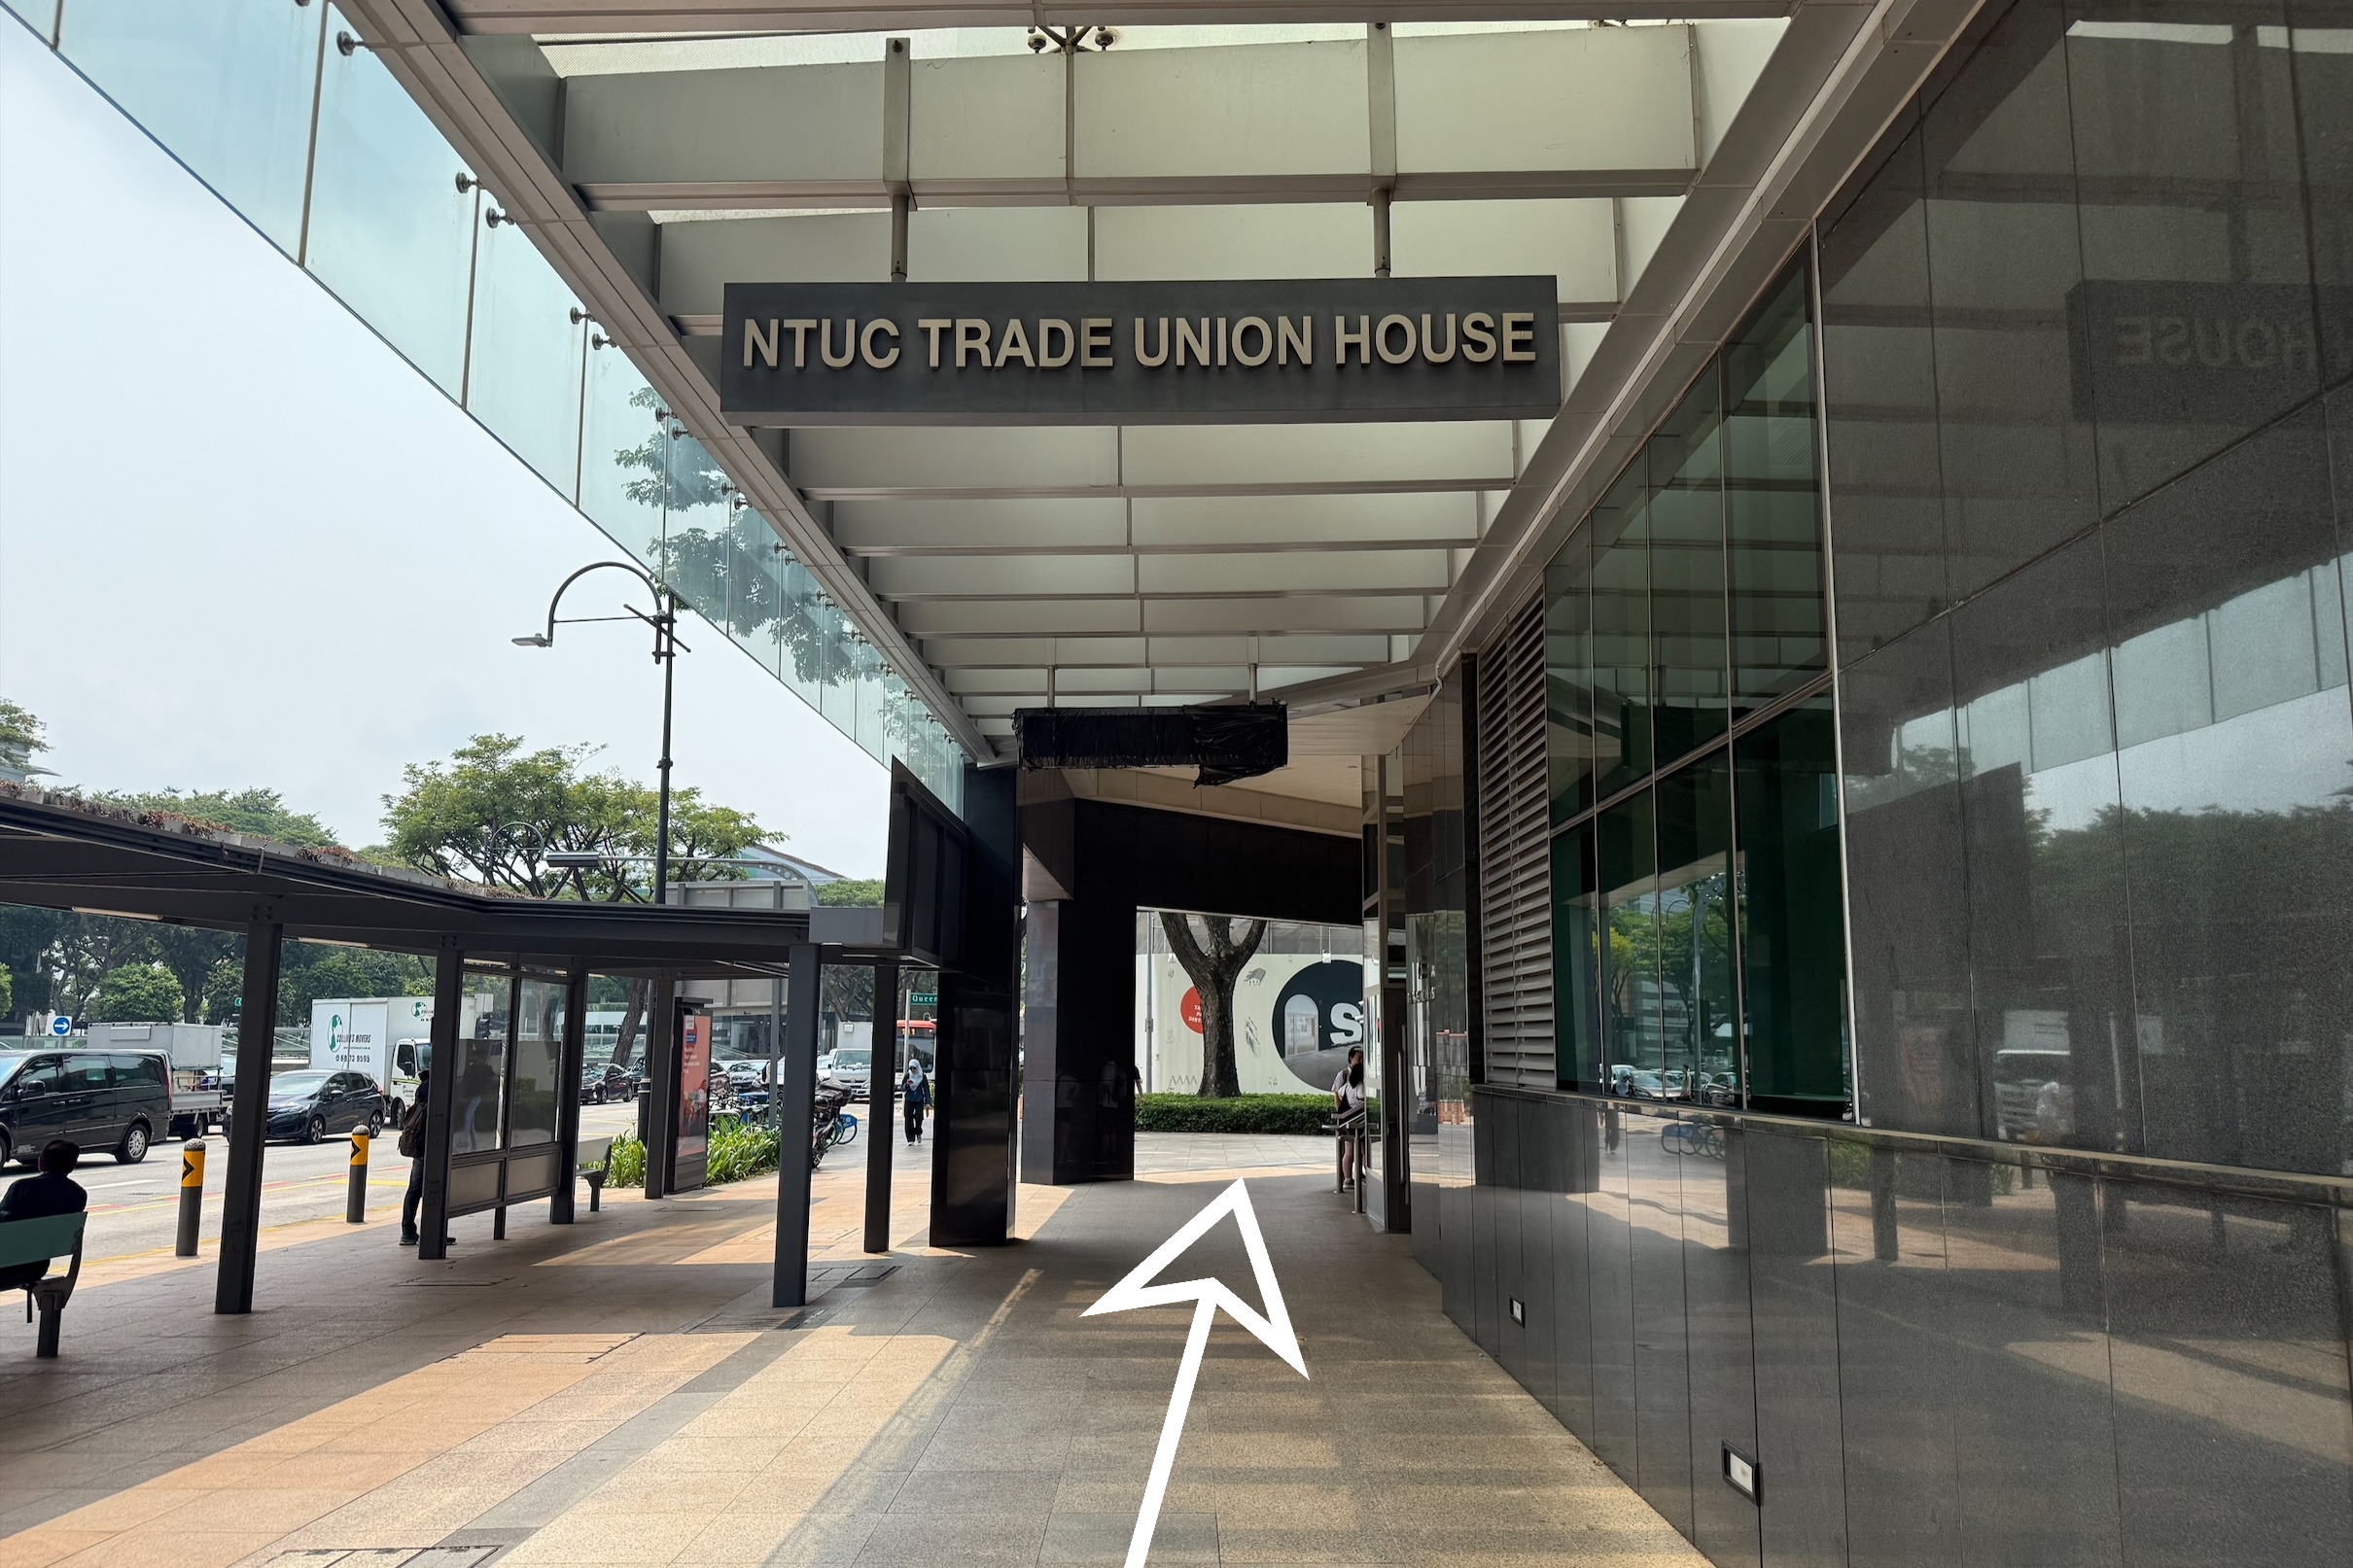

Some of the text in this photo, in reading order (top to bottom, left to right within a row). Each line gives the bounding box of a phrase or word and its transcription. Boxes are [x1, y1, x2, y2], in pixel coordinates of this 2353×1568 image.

[743, 311, 1537, 369] NTUC TRADE UNION HOUSE
